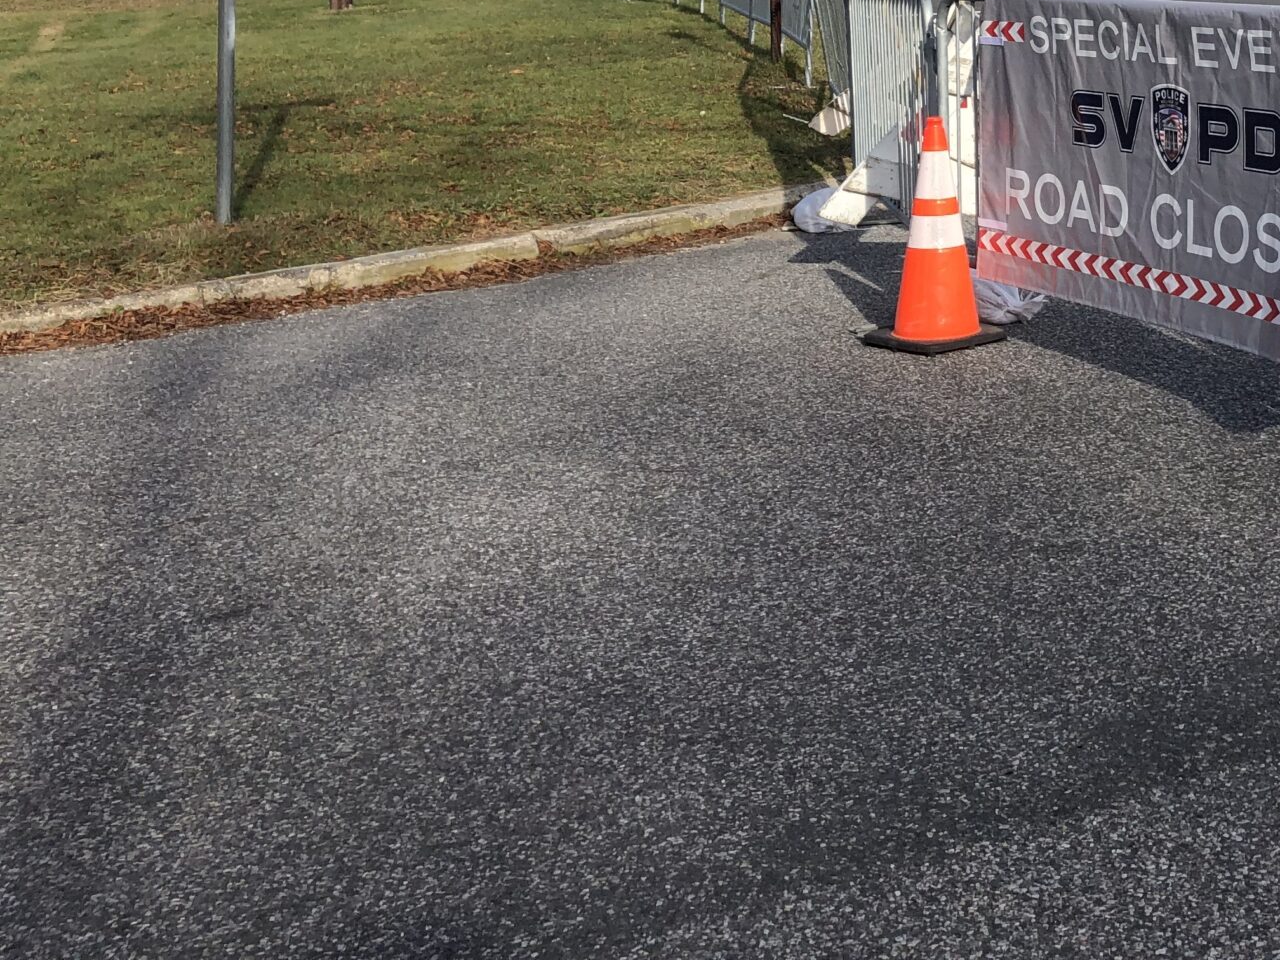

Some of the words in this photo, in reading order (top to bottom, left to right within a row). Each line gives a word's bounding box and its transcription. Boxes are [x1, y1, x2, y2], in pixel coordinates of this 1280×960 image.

[1030, 15, 1178, 65] SPECIAL
[1070, 89, 1145, 153] SV
[1155, 89, 1185, 104] POLICE
[1005, 167, 1129, 239] ROAD
